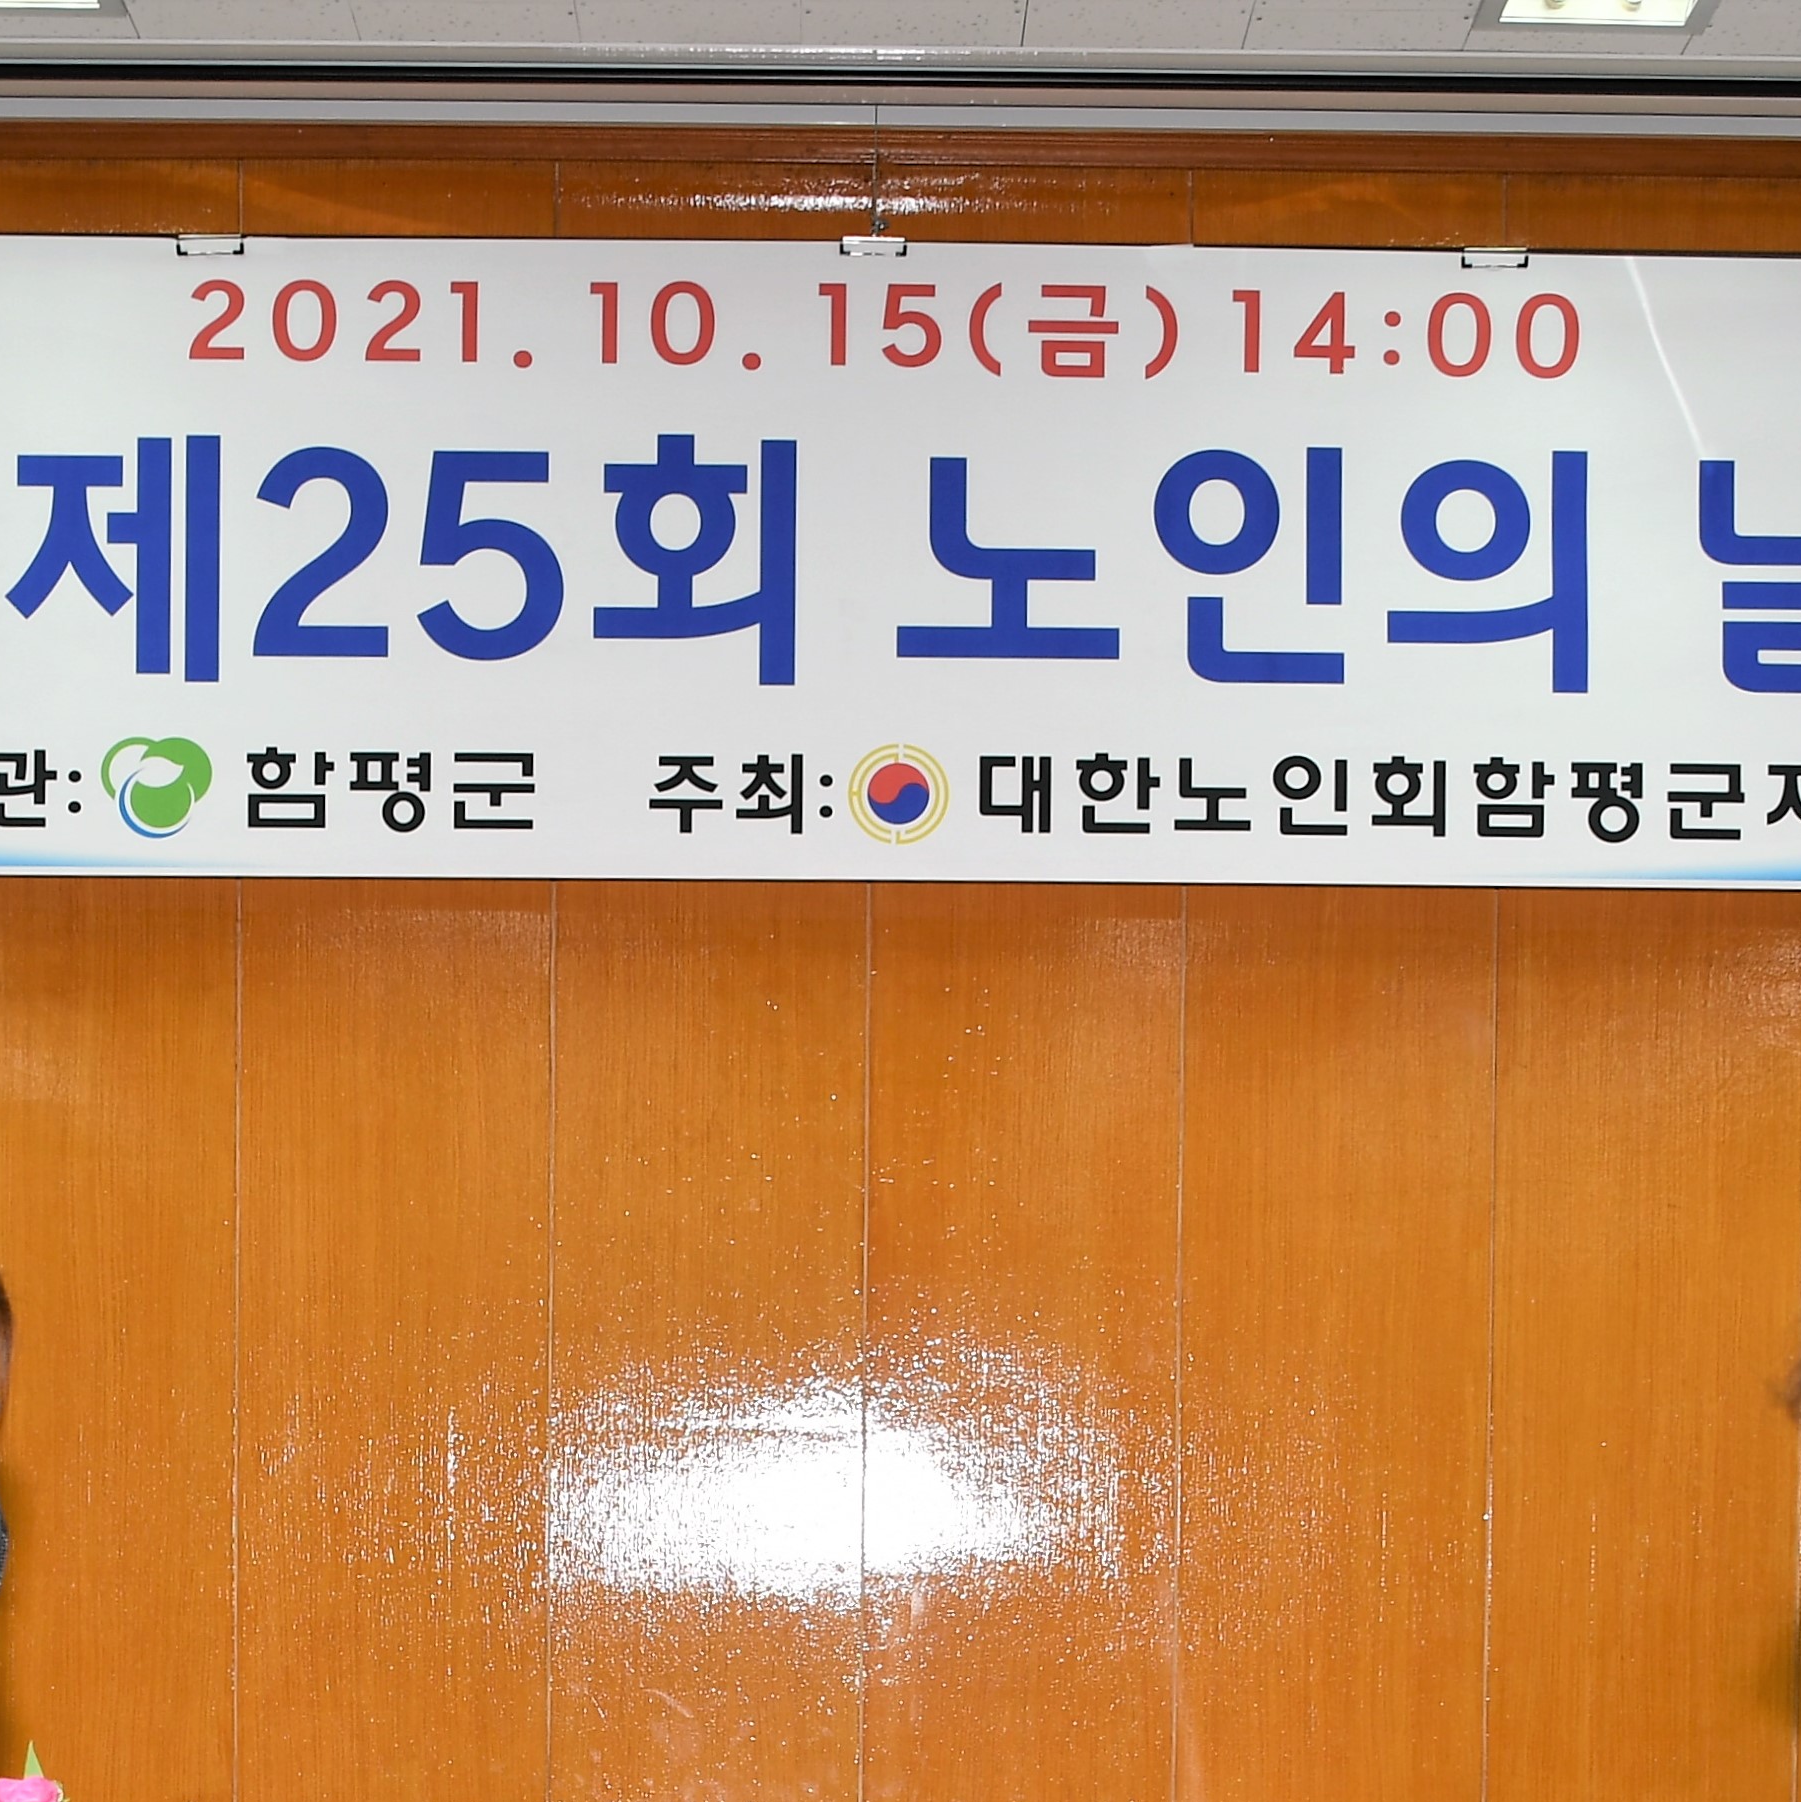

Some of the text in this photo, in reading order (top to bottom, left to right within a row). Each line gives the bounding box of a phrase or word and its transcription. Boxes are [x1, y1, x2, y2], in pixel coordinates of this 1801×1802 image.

[189, 279, 1580, 379] 2021. 10. 15(금) 14:00
[6, 434, 797, 685] 제25회
[896, 447, 1589, 693] 노인의
[245, 746, 537, 833] 함평군
[647, 753, 833, 835] 주최:
